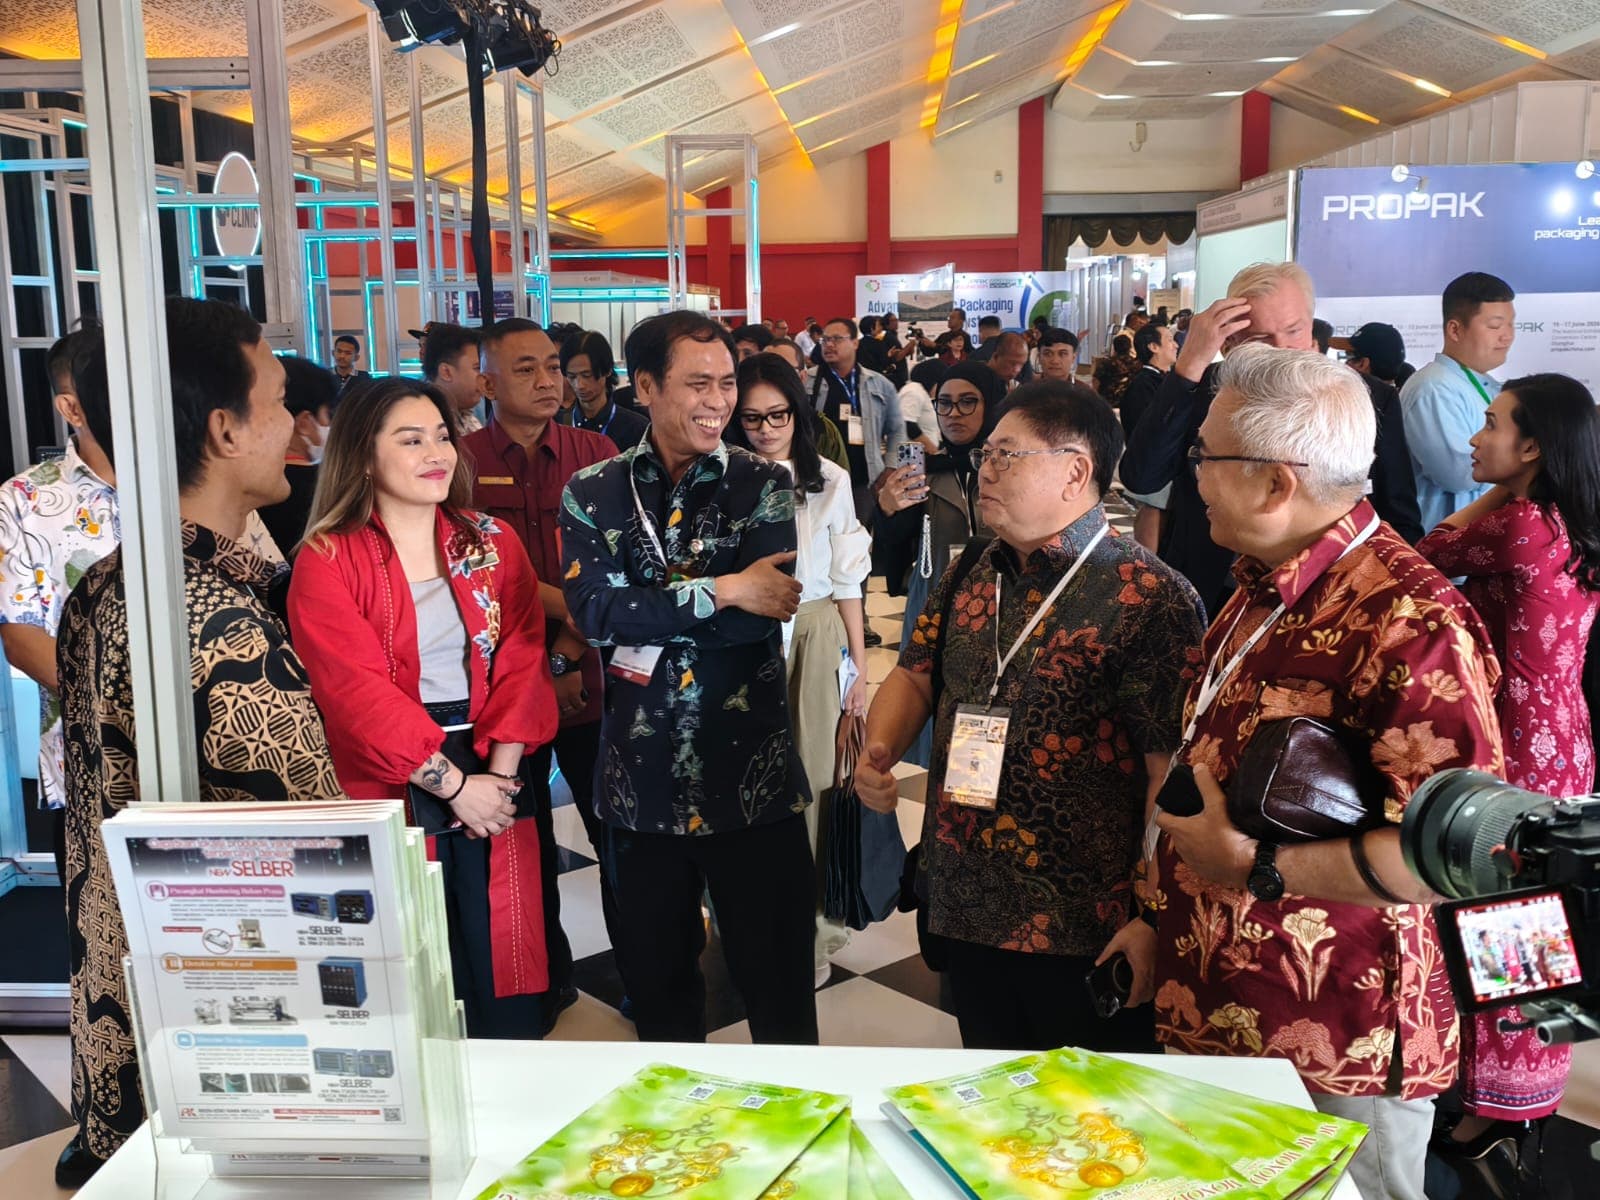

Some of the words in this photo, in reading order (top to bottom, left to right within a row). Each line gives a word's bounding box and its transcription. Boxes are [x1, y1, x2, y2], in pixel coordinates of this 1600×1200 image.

[1322, 191, 1487, 221] PROPAK
[1534, 228, 1600, 241] packaging
[960, 298, 1013, 314] Packaging
[231, 860, 294, 877] SELBER
[309, 926, 343, 936] SELBER
[336, 1009, 370, 1020] SELBER
[339, 1079, 373, 1089] SELBER
